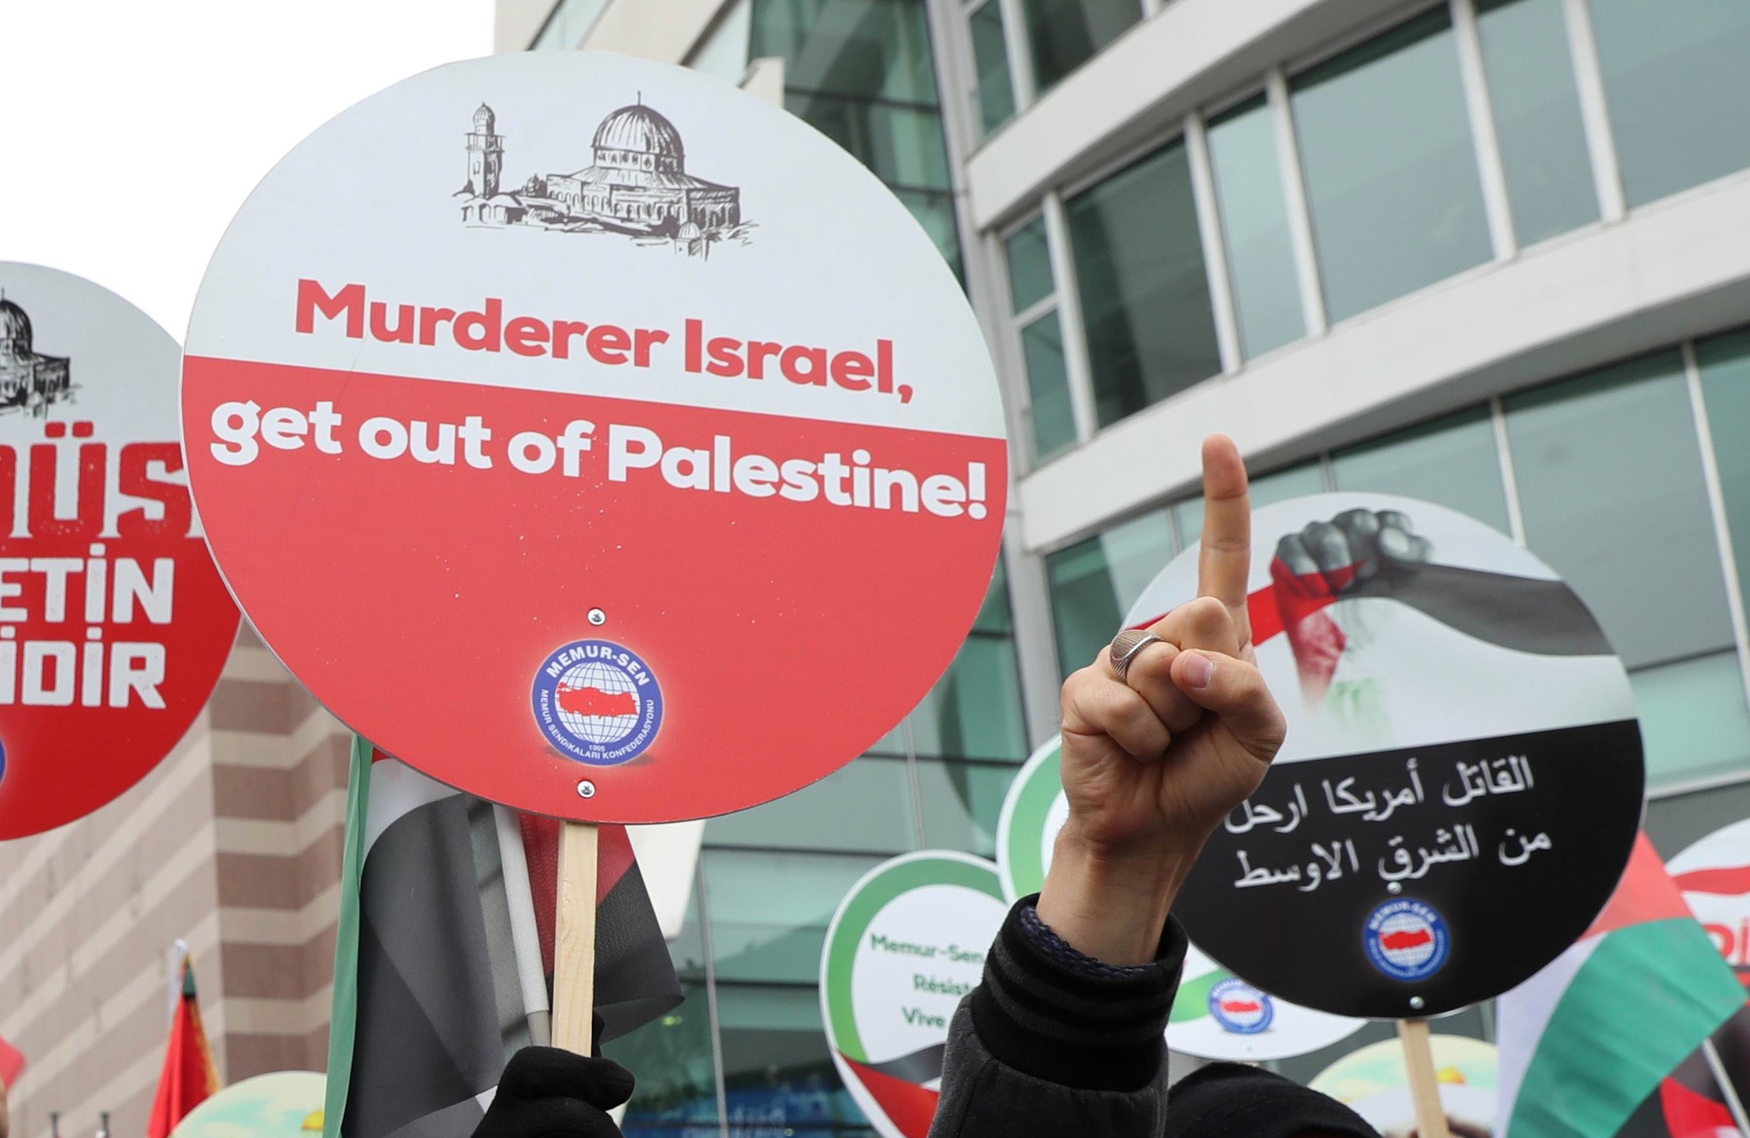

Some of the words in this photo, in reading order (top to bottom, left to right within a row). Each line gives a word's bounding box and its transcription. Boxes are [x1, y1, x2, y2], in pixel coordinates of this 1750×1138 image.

[295, 278, 668, 370] Murderer
[684, 318, 914, 404] Israel,
[210, 399, 342, 467] get
[359, 414, 492, 470] out
[507, 419, 600, 478] of
[608, 424, 988, 520] Palestine!
[546, 645, 650, 686] MEMUR-SEN
[1322, 759, 1425, 821] أمريكا
[1442, 756, 1534, 806] القاتل
[1234, 839, 1358, 891] الاوسط
[1378, 824, 1479, 883] الشرق
[1498, 831, 1552, 865] من
[901, 1006, 945, 1028] Vive
